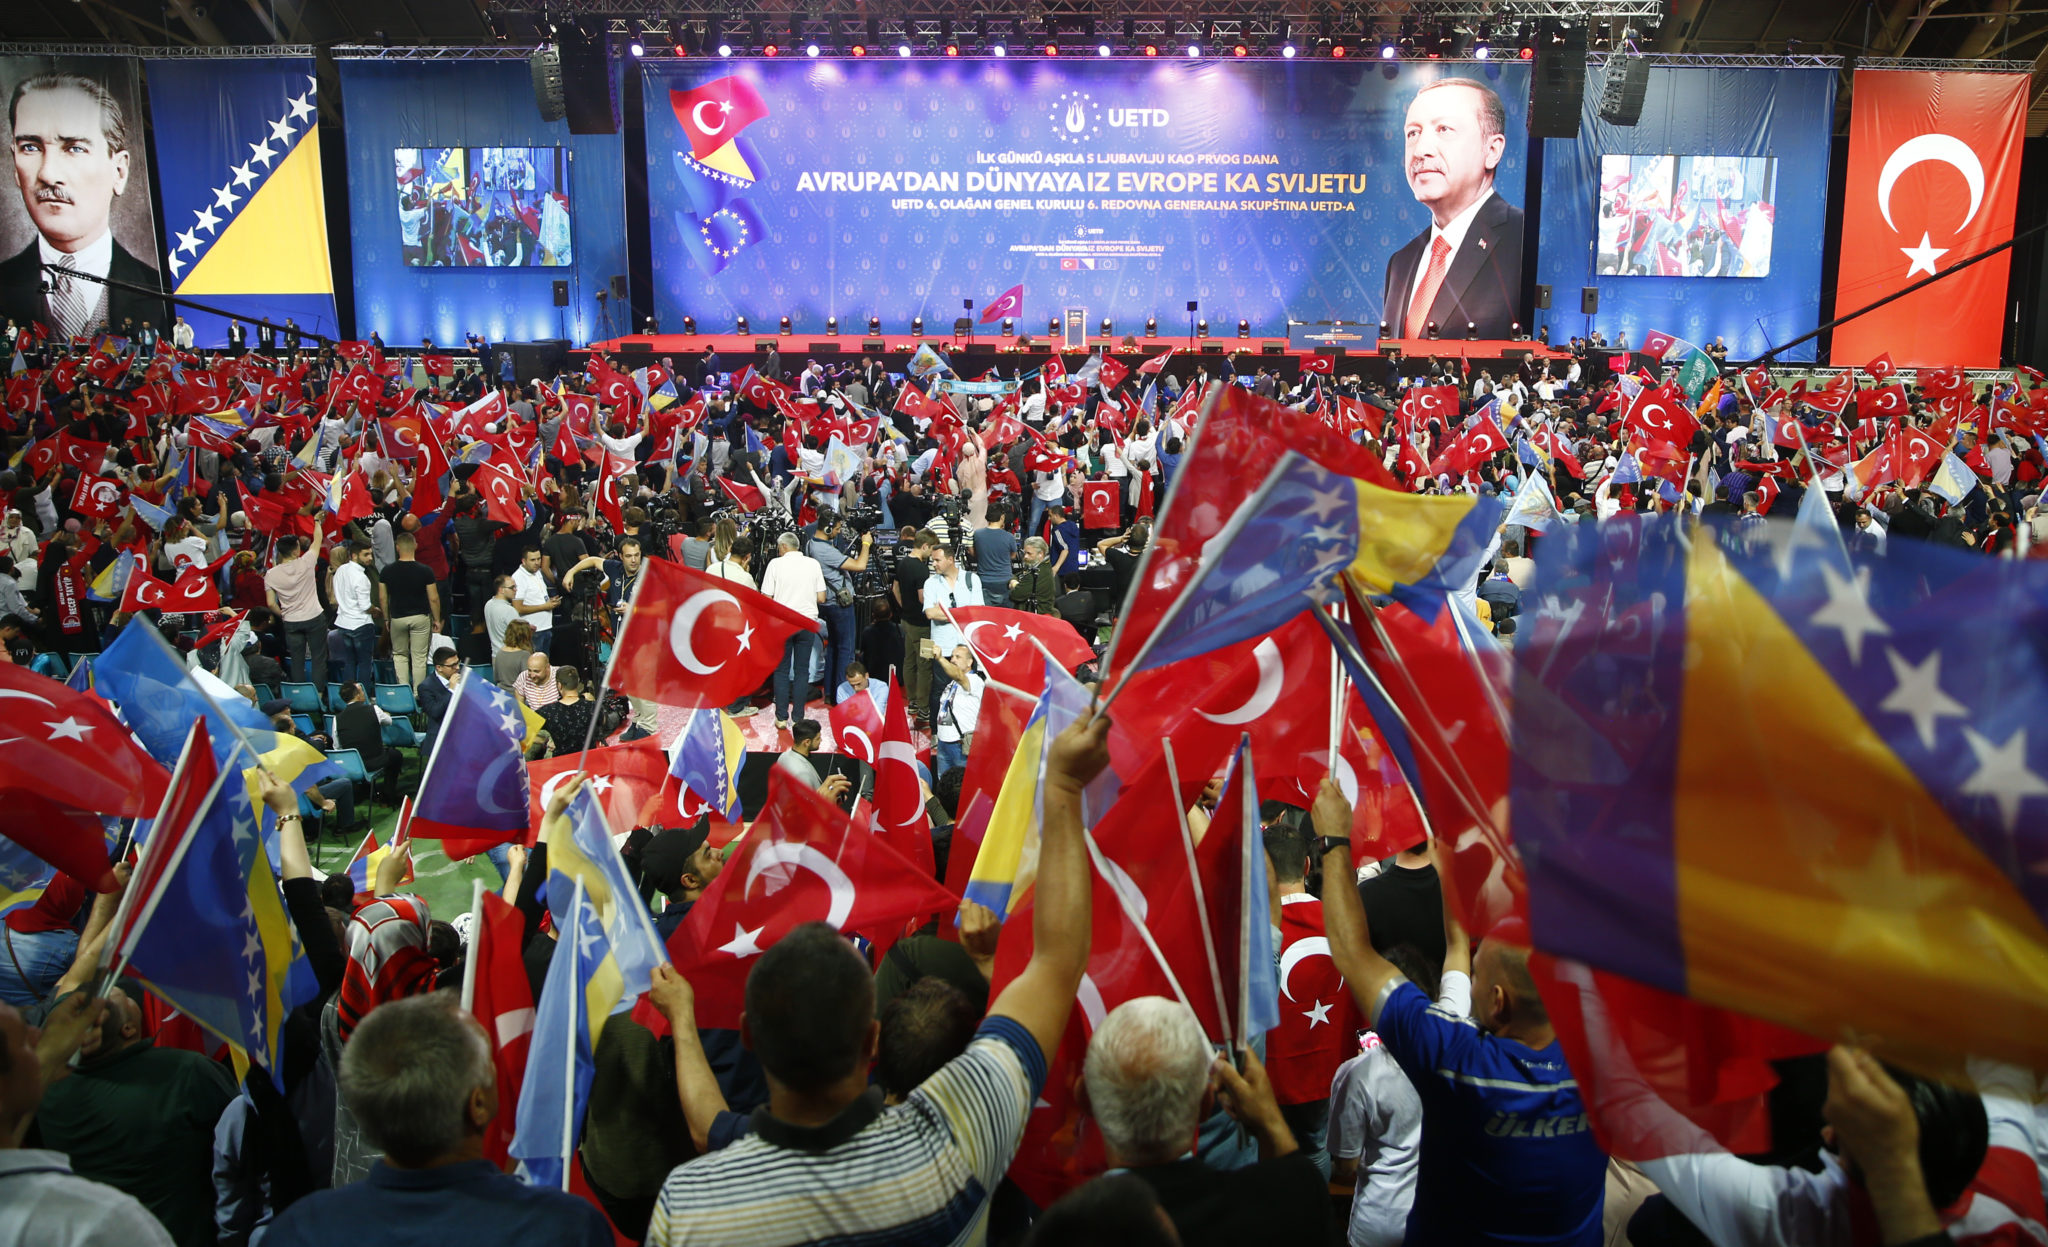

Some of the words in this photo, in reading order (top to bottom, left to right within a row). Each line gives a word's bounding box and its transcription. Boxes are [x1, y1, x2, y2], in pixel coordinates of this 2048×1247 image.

[1108, 108, 1170, 127] UETD
[976, 150, 996, 164] İLK
[999, 150, 1042, 164] GÜNKÜ
[1045, 153, 1085, 166] AŞKLA
[1087, 153, 1094, 164] S
[1097, 153, 1165, 164] LJUBAVLJU
[1167, 154, 1195, 164] KAO
[1197, 154, 1240, 165] PRVOG
[1243, 154, 1279, 165] DANA
[796, 171, 959, 192] AVRUPA'DAN
[966, 166, 1085, 192] DÜNYAYA
[1087, 172, 1110, 192] IZ
[1117, 172, 1218, 192] EVROPE
[1225, 173, 1260, 193] KA
[1265, 173, 1366, 194] SVIJETU
[891, 199, 923, 210] UETD
[926, 199, 938, 210] 6.
[942, 197, 991, 210] OLAĞAN
[994, 199, 1033, 210] GENEL
[1036, 199, 1085, 210] KURULU
[1087, 199, 1098, 210] 6.
[1101, 199, 1160, 210] REDOVNA
[1163, 199, 1237, 211] GENERALNA
[1240, 197, 1307, 211] SKUPŠTINA
[1310, 201, 1355, 212] UETD-A
